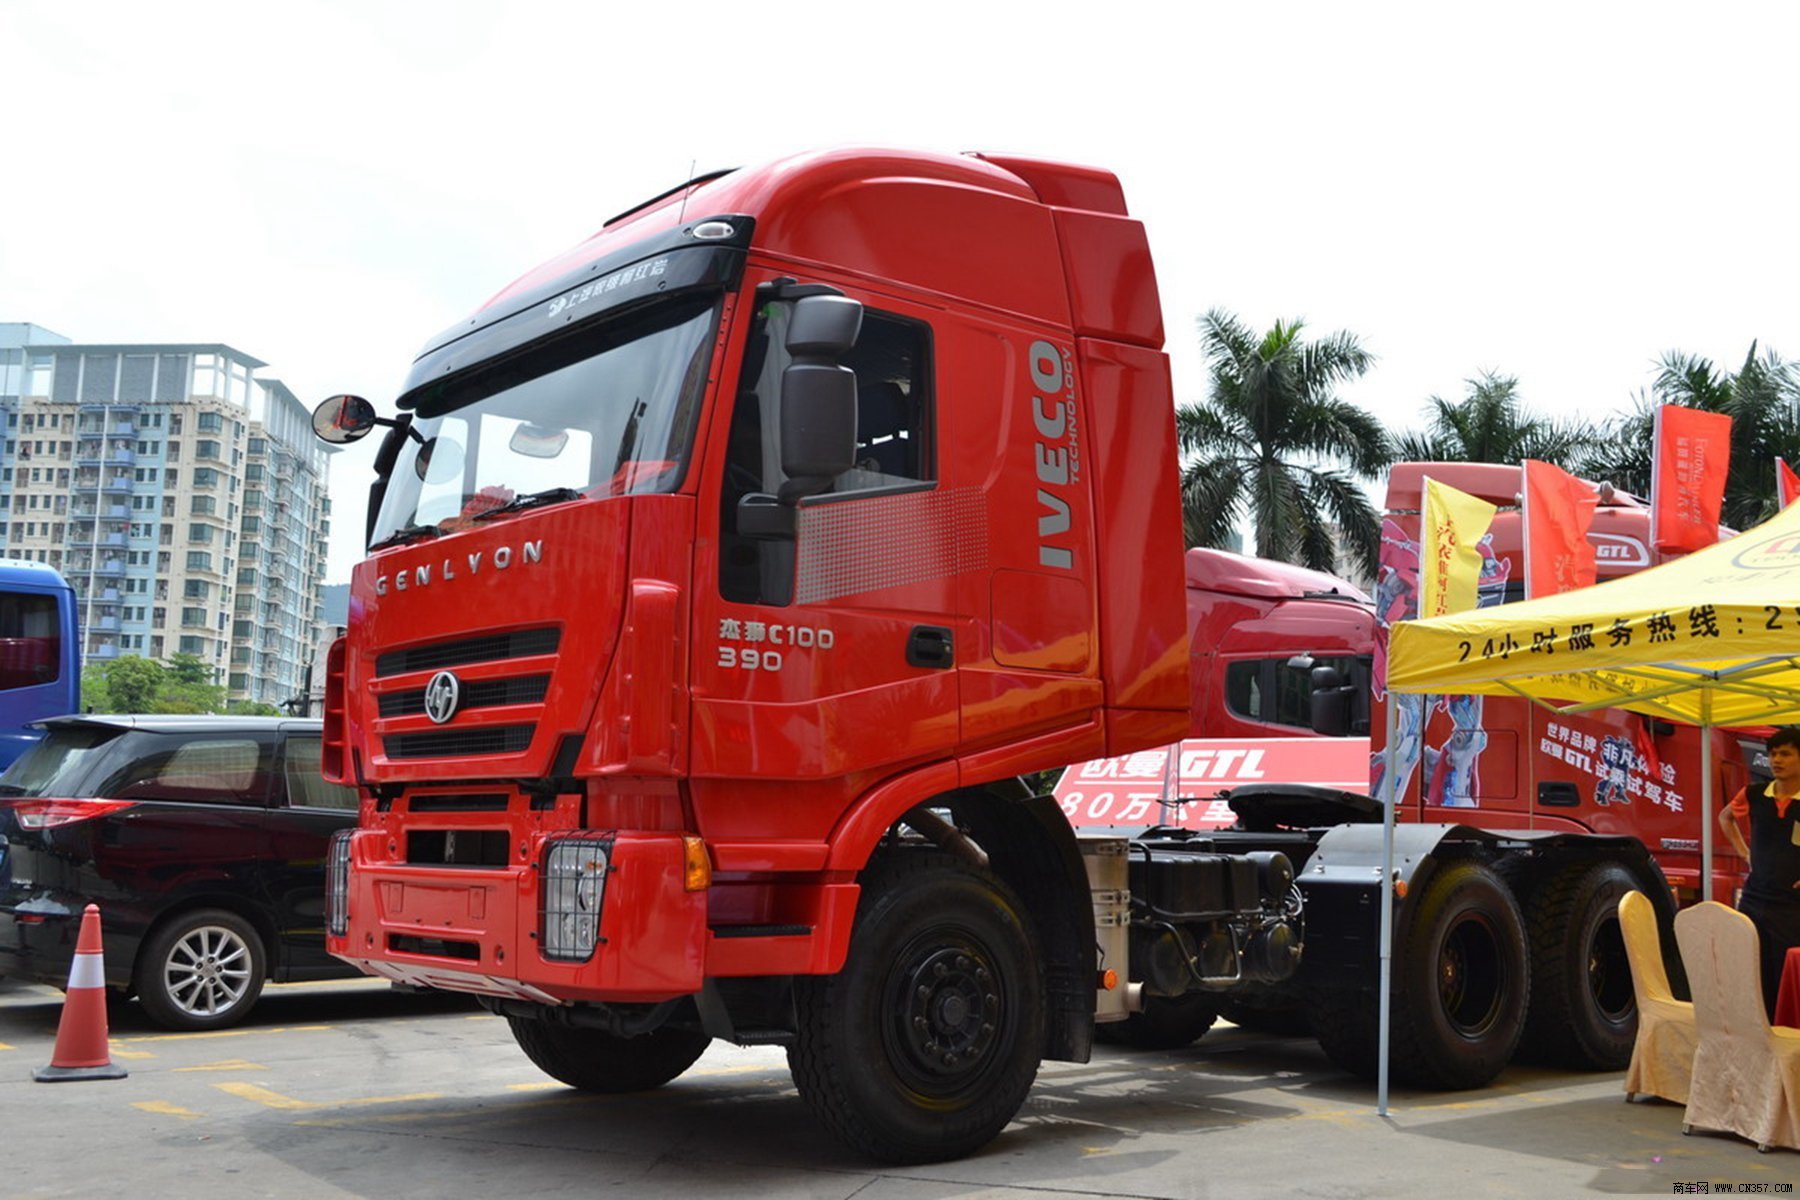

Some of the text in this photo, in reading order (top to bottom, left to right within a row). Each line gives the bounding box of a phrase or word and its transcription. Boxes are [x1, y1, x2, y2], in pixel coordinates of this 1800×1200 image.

[1062, 347, 1080, 485] TECHNOLOGY
[1029, 340, 1073, 569] IVECO
[1596, 545, 1630, 558] GTL
[375, 540, 543, 596] GENLYON
[717, 646, 782, 671] 390
[1547, 722, 1598, 754] 世界品牌
[1179, 750, 1265, 778] GTL
[1564, 747, 1593, 773] GTL
